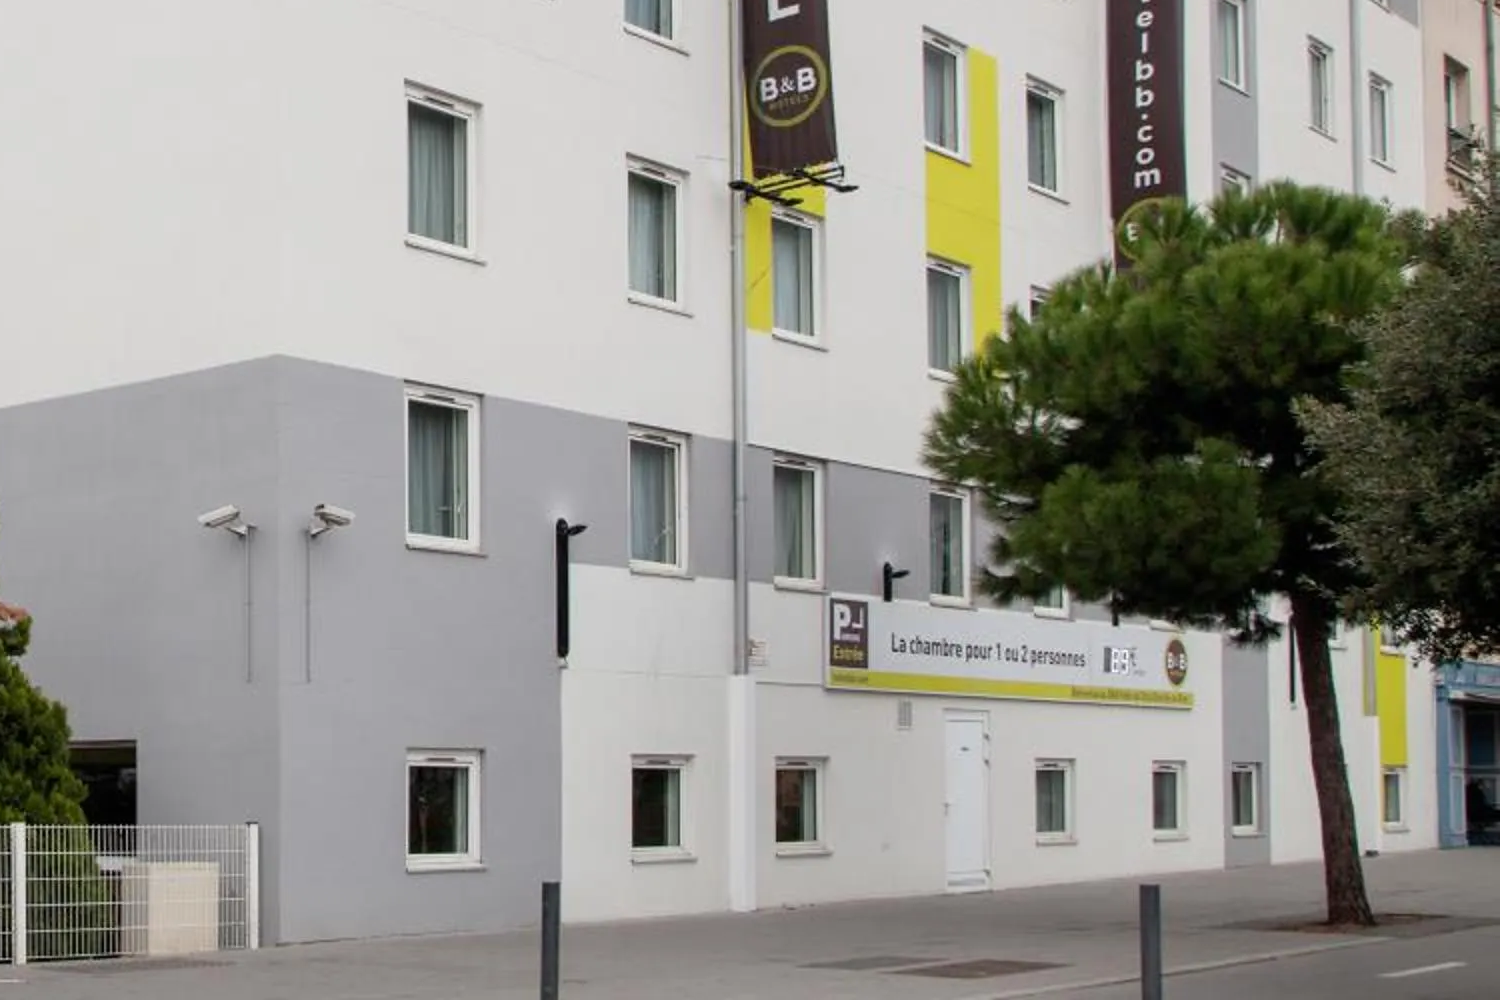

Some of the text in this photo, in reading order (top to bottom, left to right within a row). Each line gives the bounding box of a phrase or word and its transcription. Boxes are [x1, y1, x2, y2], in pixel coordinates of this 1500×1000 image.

[760, 66, 817, 104] B&B
[891, 632, 1086, 668] La chambre pour 1 ou 2 personnes
